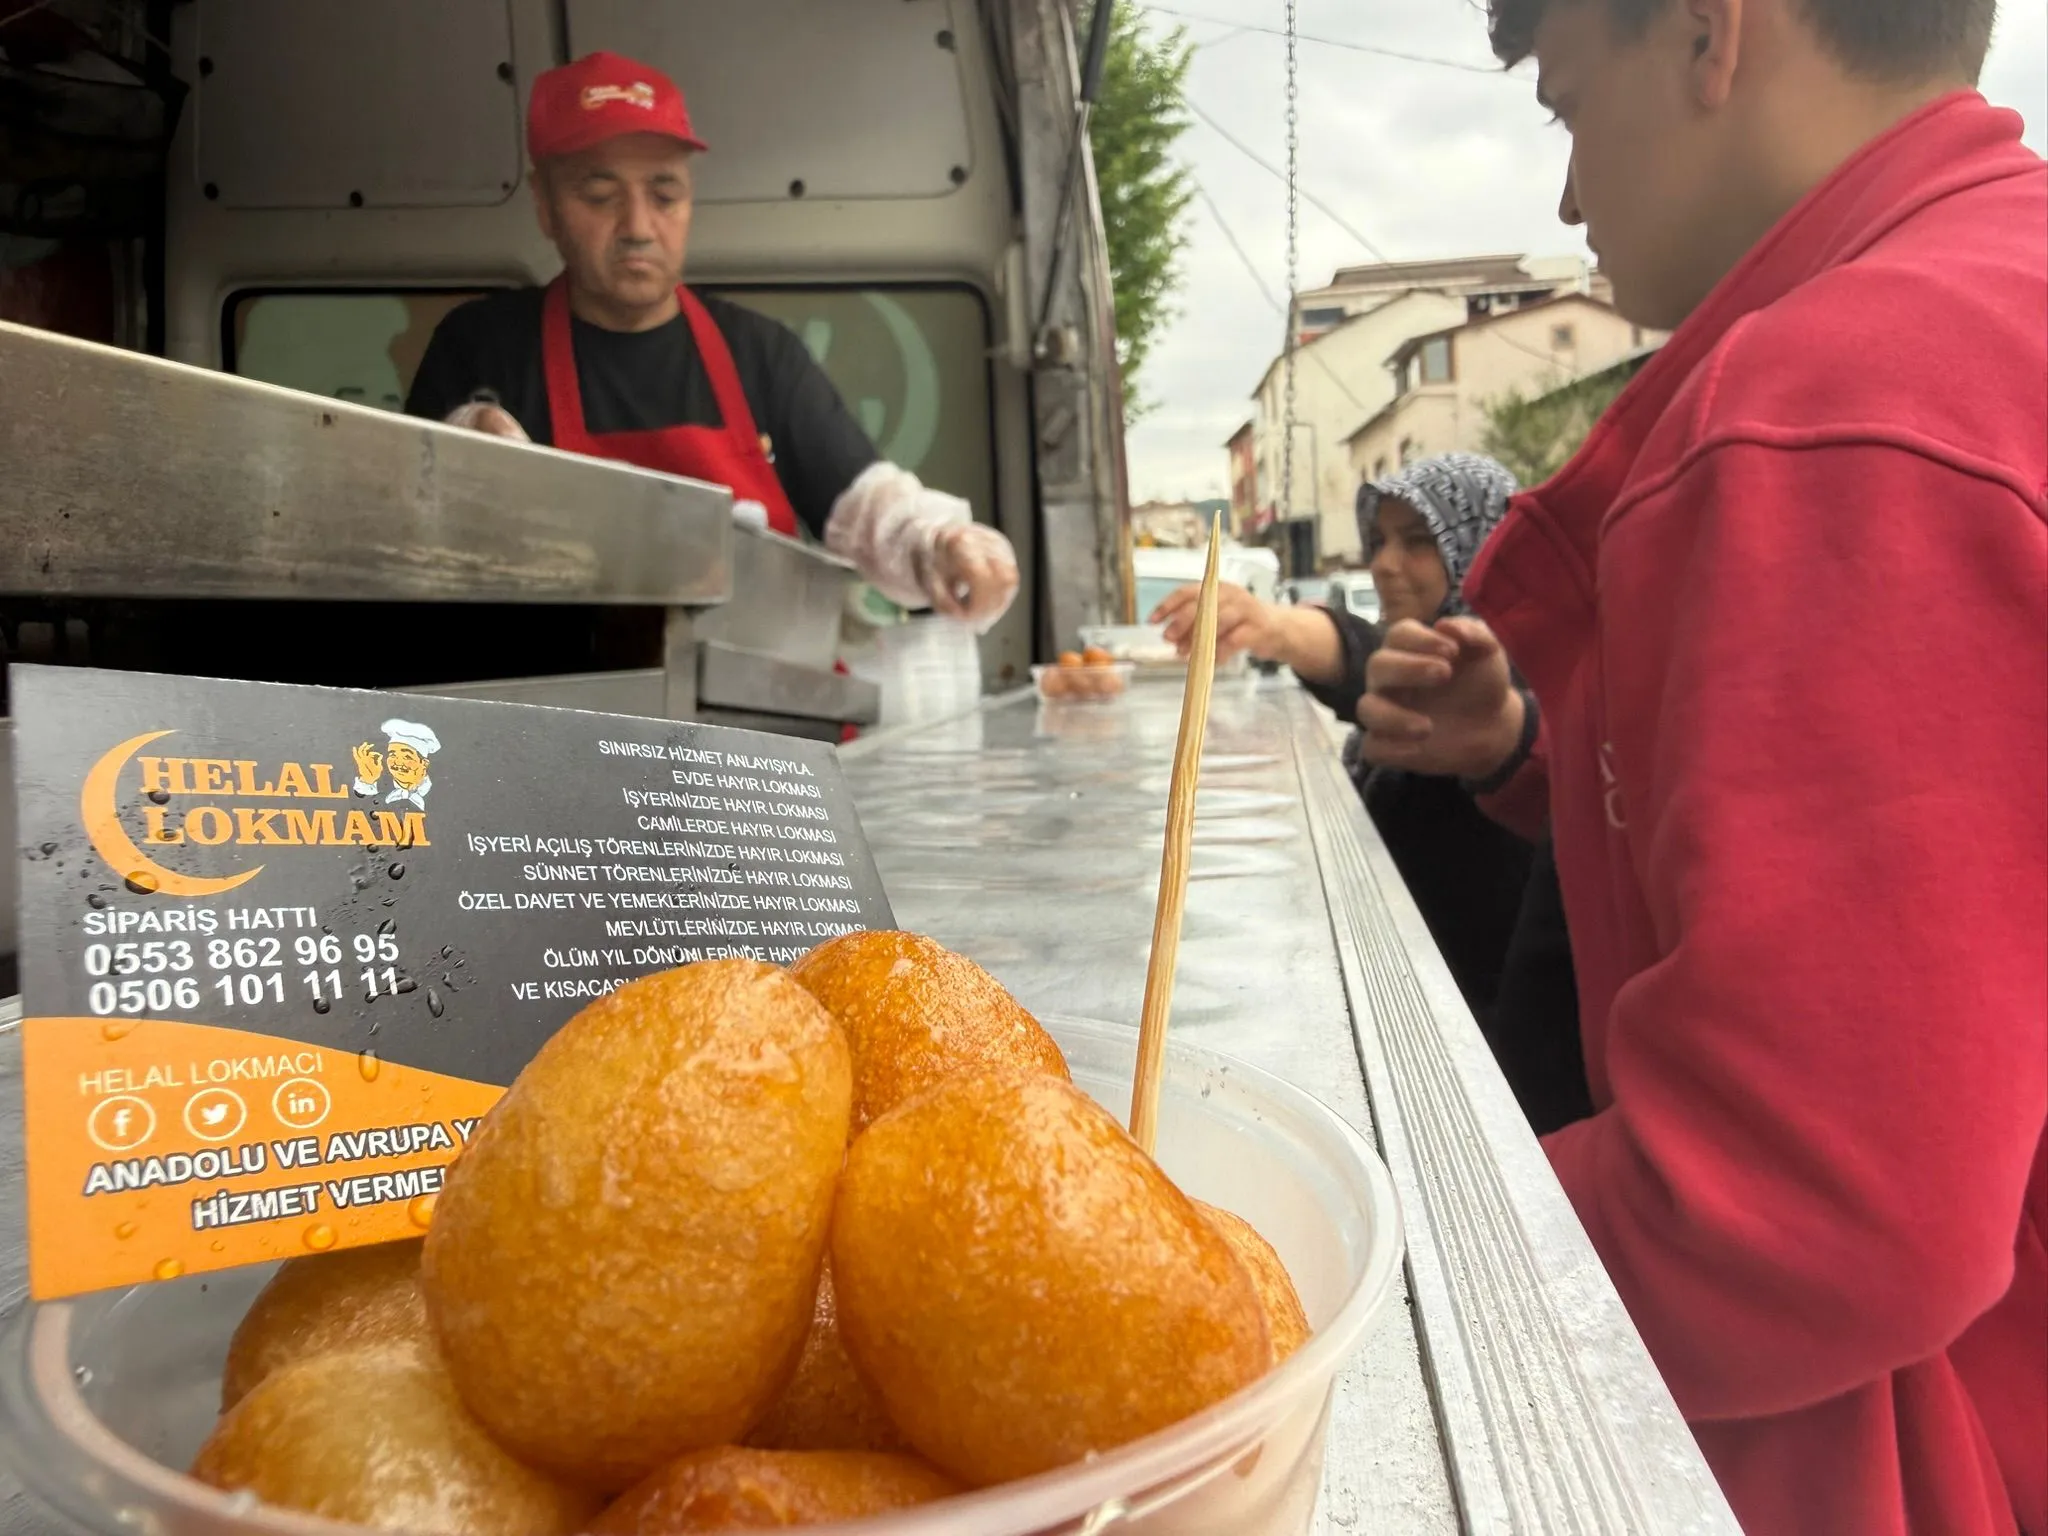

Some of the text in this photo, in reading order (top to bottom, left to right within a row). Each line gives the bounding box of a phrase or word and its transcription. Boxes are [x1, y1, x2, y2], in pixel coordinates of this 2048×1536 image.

[599, 740, 667, 760] SINIRSIZ
[670, 745, 723, 766] HİZMET
[137, 757, 348, 798] HELAL
[672, 770, 822, 798] EVDE HAYIR LOKMASI
[622, 787, 829, 821] İŞYERİNİZDE HAYIR LOKMASI
[143, 807, 431, 846] LOKMAM
[637, 815, 837, 844] CAMİLERDE HAYIR LOKMASI
[467, 833, 845, 866] İŞYERİ AÇILIŞ TÖRENLERİNİZDE HAYIR LOKMASI
[523, 862, 853, 890] SÜNNET TÖRENLERİNİZDE HAYIR LOKMASI
[458, 890, 861, 914] ÖZEL DAVET VE YEMEKLERİNİZDE HAYIR LOKMASI
[83, 904, 317, 936] SİPARİŞ HATTI
[605, 917, 760, 937] MEVLÜTLERİNİZDE
[761, 920, 807, 936] HAYIR
[84, 933, 399, 976] 0553 862 96 95
[543, 948, 599, 968] ÖLÜM
[601, 949, 631, 965] YIL
[88, 966, 398, 1015] 0506 101 11 11
[511, 982, 540, 1000] VE
[79, 1052, 323, 1095] HELAL LOKMACI
[83, 1144, 266, 1195] ANADOLU
[273, 1137, 320, 1168] VE
[326, 1122, 452, 1162] AVRUPA
[193, 1189, 322, 1229] HİZMET
